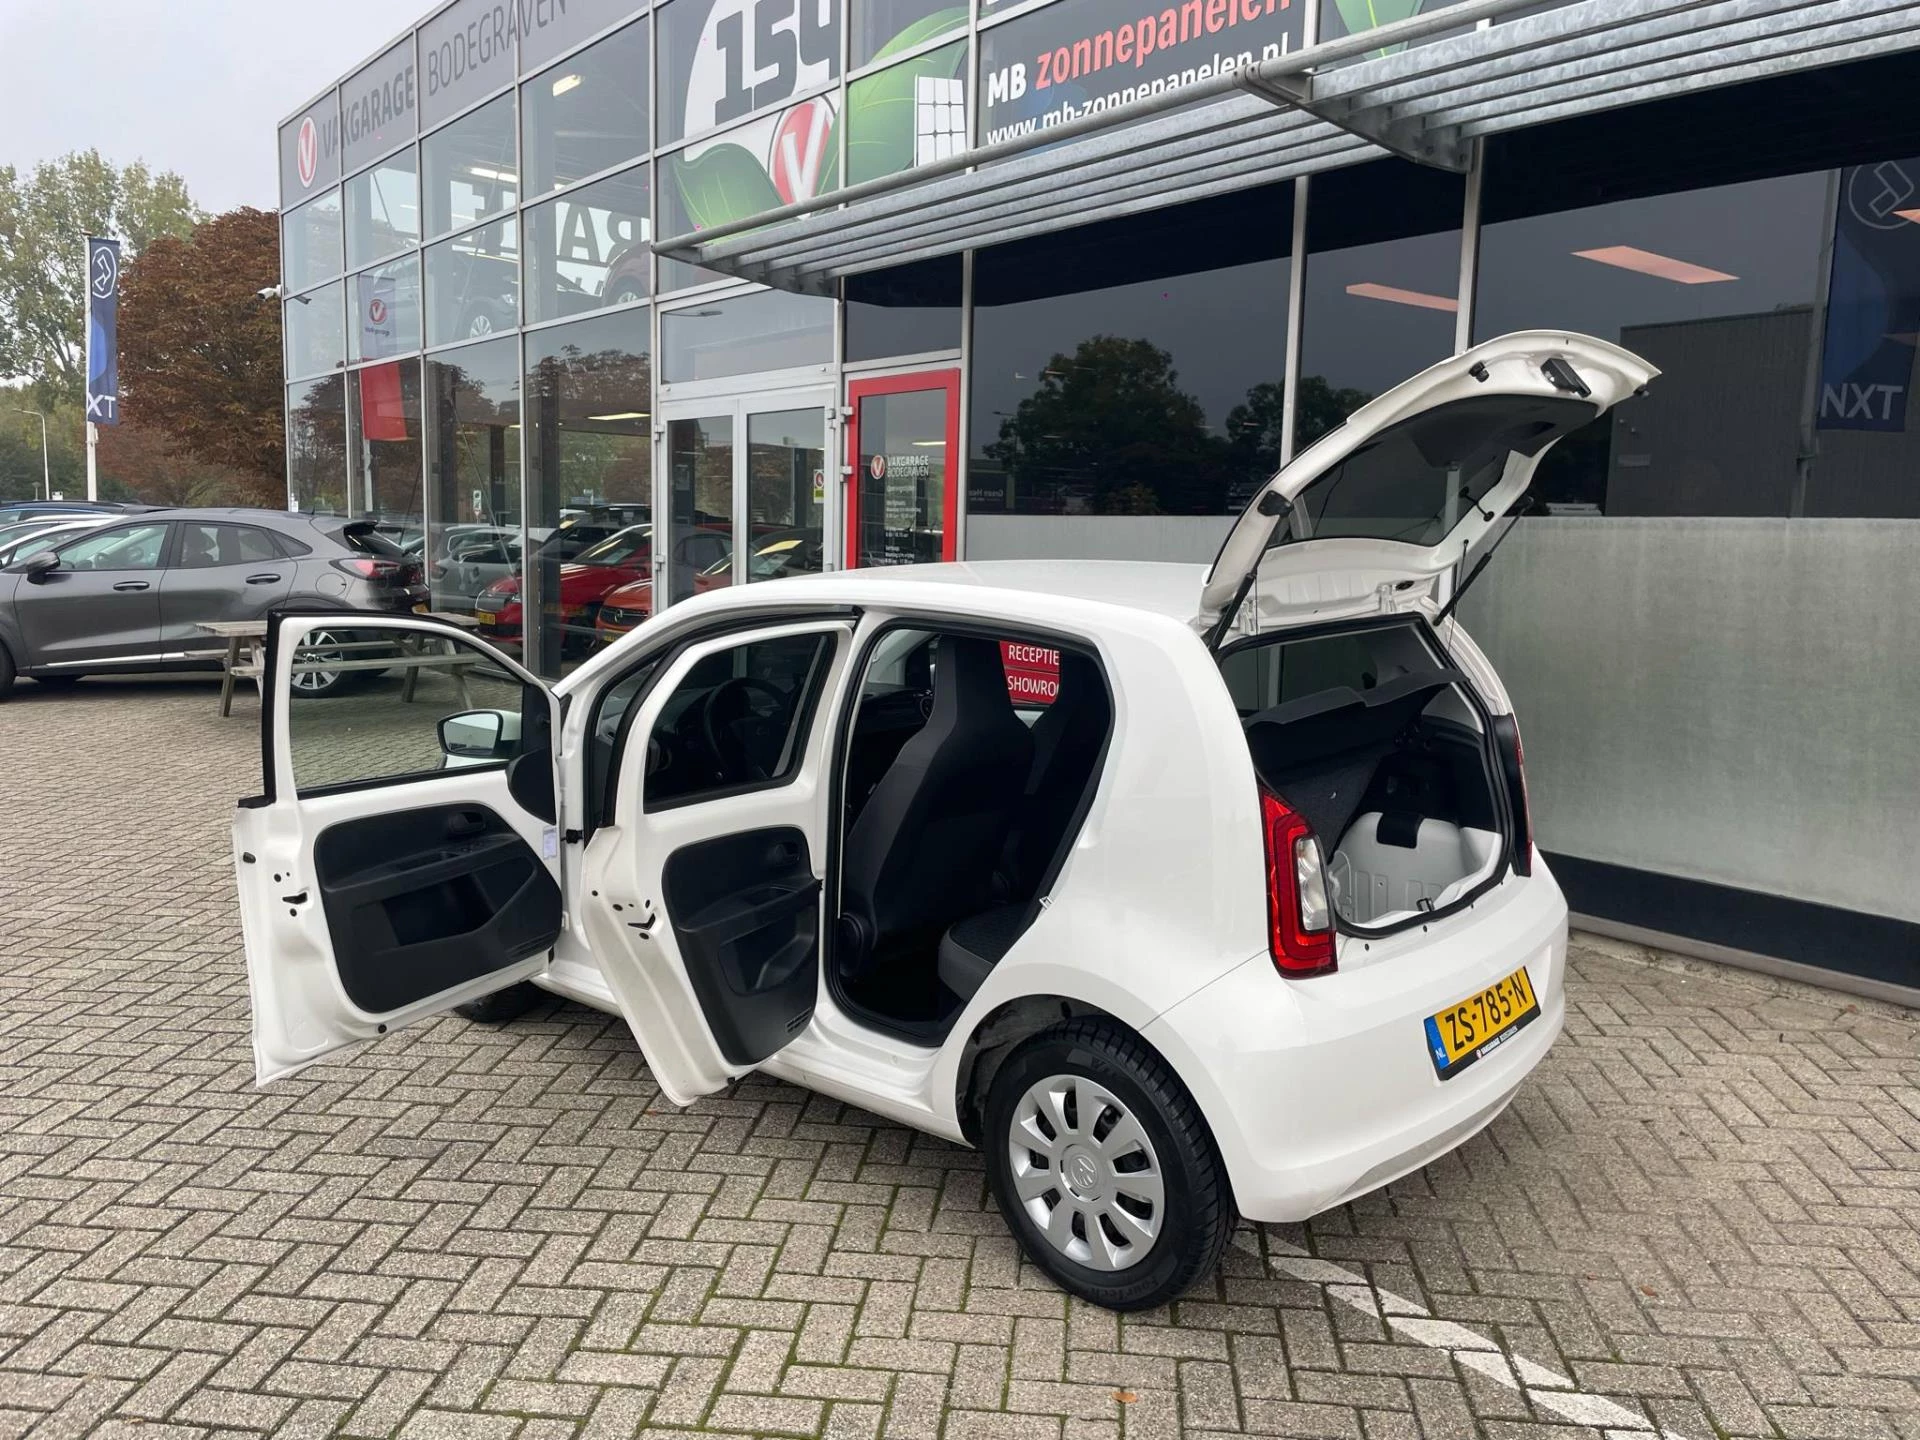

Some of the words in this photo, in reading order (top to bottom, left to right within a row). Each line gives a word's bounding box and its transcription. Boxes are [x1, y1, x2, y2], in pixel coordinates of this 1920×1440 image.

[715, 0, 843, 125] 154
[986, 32, 1289, 145] wwwmb-zonnepanelennl
[987, 63, 1026, 107] MB
[322, 65, 414, 159] VAKGARAGE
[87, 391, 116, 418] XT
[1820, 383, 1904, 420] NXT
[1008, 644, 1060, 666] RECEPTIE
[1007, 675, 1060, 697] SHOWRO
[1445, 972, 1528, 1051] ZS-785-N
[1435, 1047, 1446, 1060] NL
